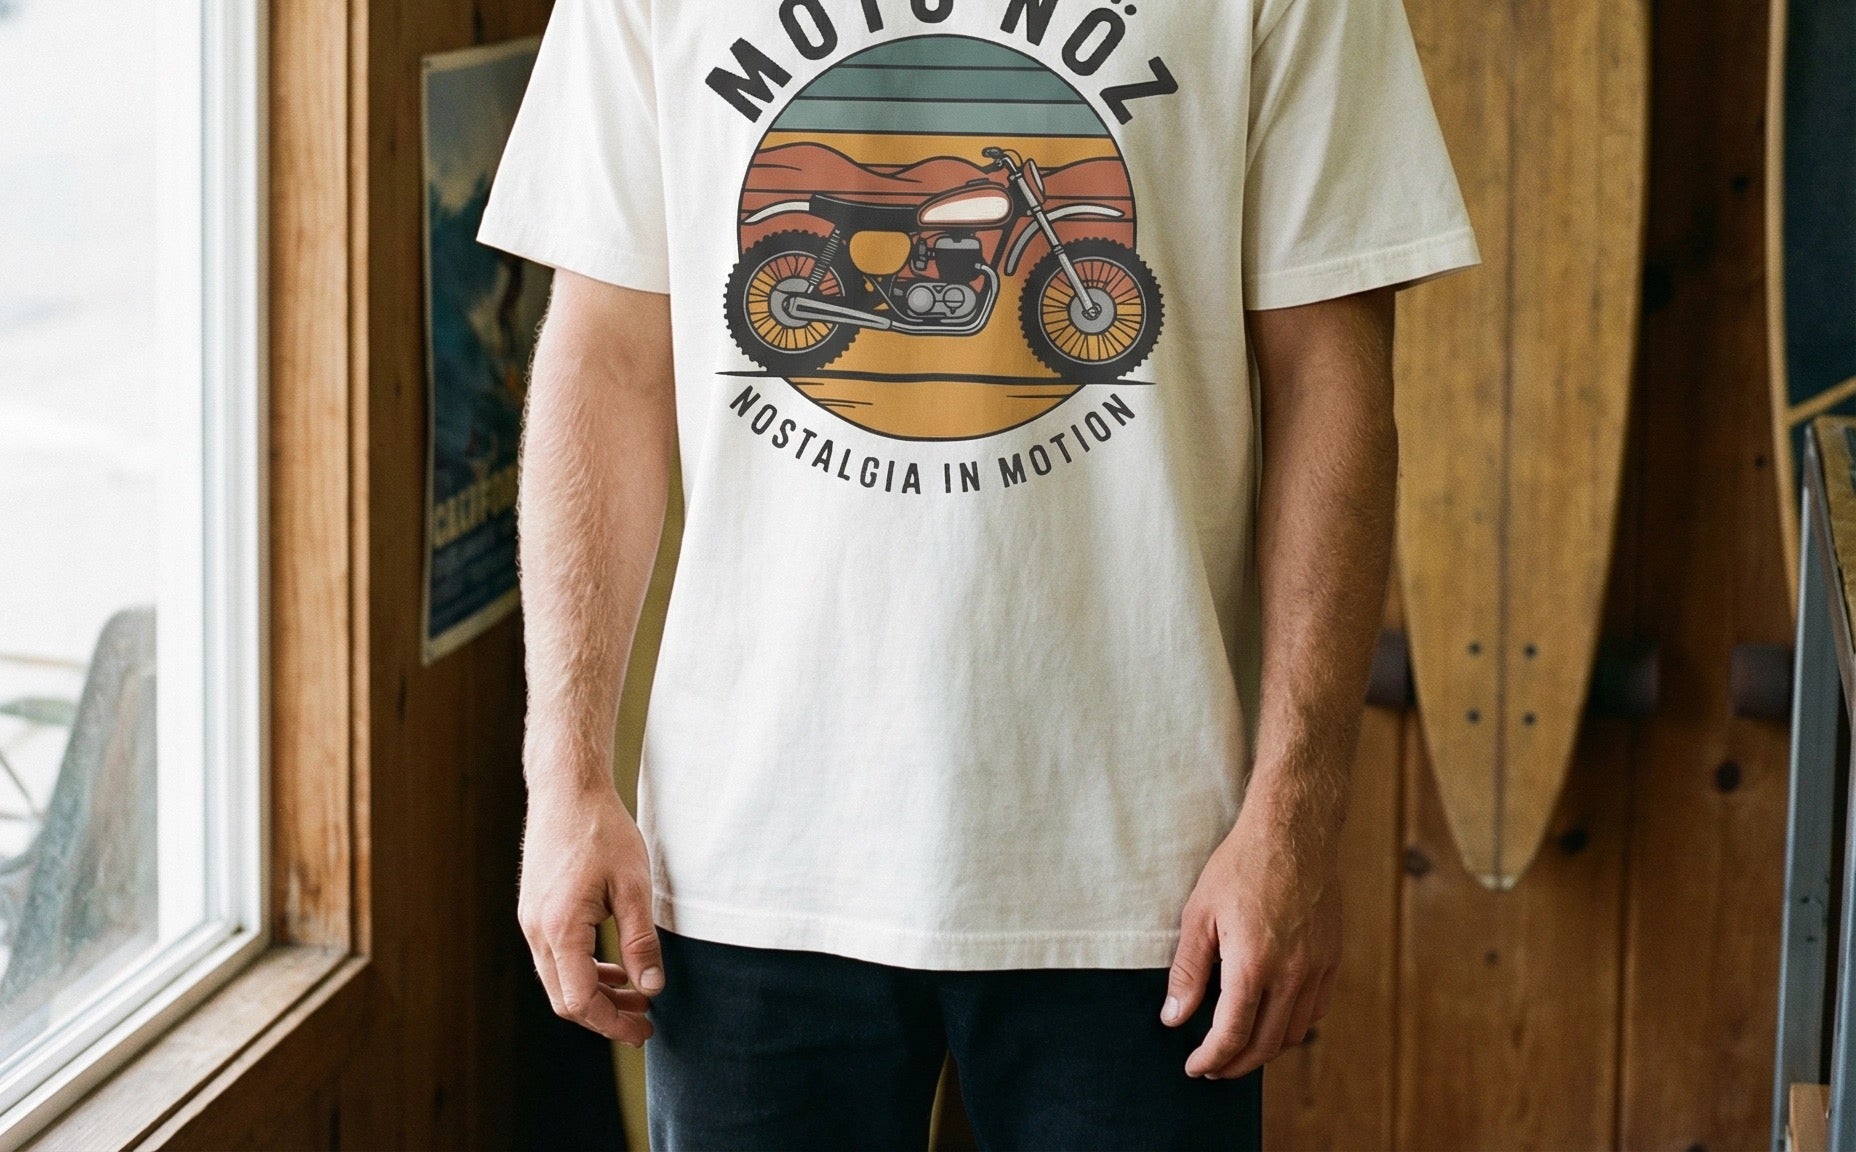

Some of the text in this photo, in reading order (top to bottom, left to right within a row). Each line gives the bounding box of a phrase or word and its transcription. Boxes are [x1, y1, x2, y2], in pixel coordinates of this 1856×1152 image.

[729, 385, 1136, 495] NOSTALGIA IN MOTION
